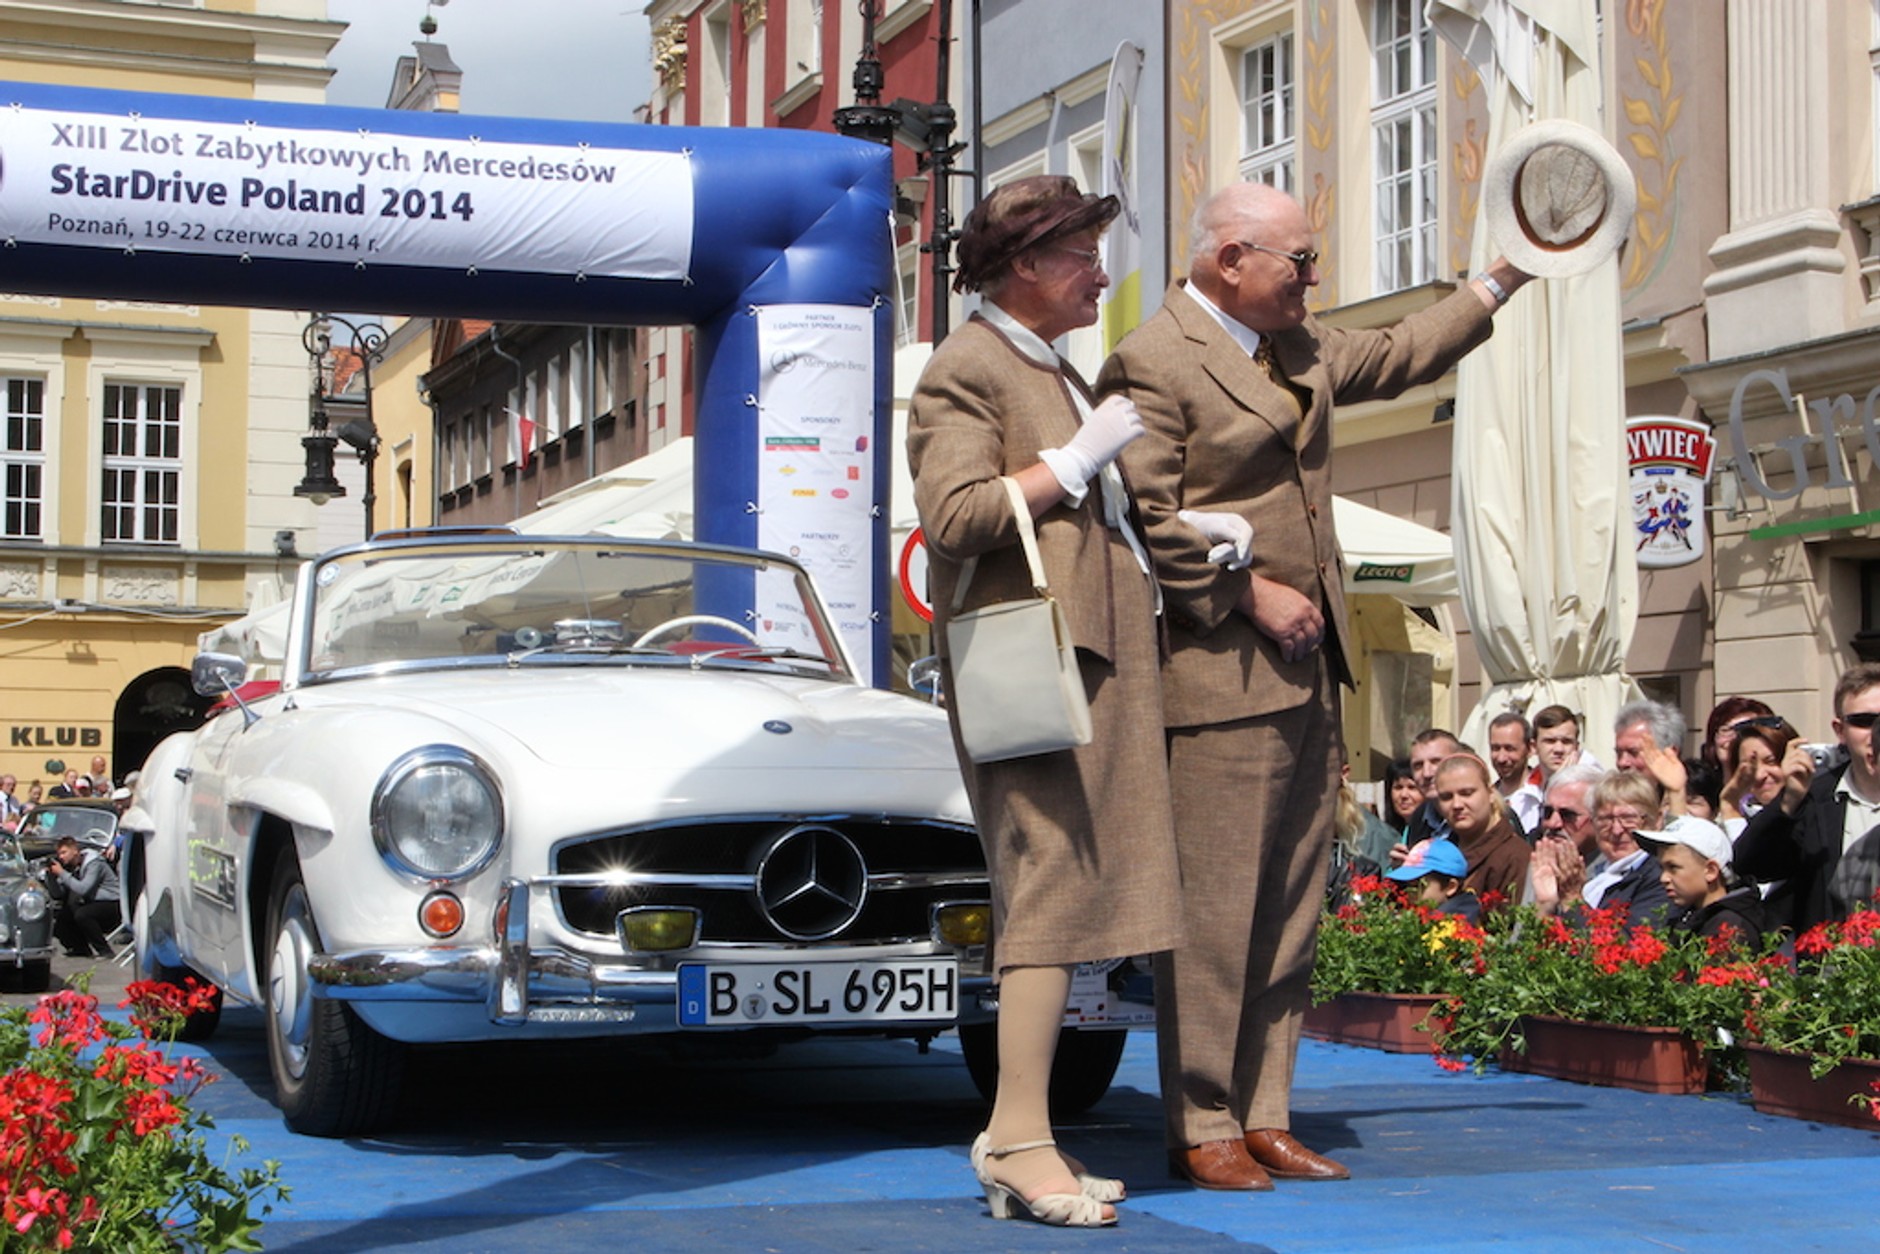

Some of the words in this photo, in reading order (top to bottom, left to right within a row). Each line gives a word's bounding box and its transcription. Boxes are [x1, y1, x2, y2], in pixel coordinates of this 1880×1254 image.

[51, 123, 107, 150] XIII
[120, 128, 184, 156] Zlot
[196, 133, 411, 176] Zabytkowych
[423, 149, 616, 183] Mercedesów
[51, 163, 227, 205] StarDrive
[241, 177, 366, 215] Poland
[380, 186, 474, 221] 2014
[49, 212, 134, 240] Poznań,
[144, 220, 206, 241] 19-22
[213, 225, 298, 248] czerwca
[306, 231, 361, 251] 2014
[368, 239, 380, 253] r.
[1626, 428, 1699, 461] YWIEC
[11, 727, 102, 747] KLUB
[688, 1000, 699, 1015] D
[710, 972, 738, 1017] B
[772, 970, 830, 1015] SL
[842, 967, 954, 1014] 695H
